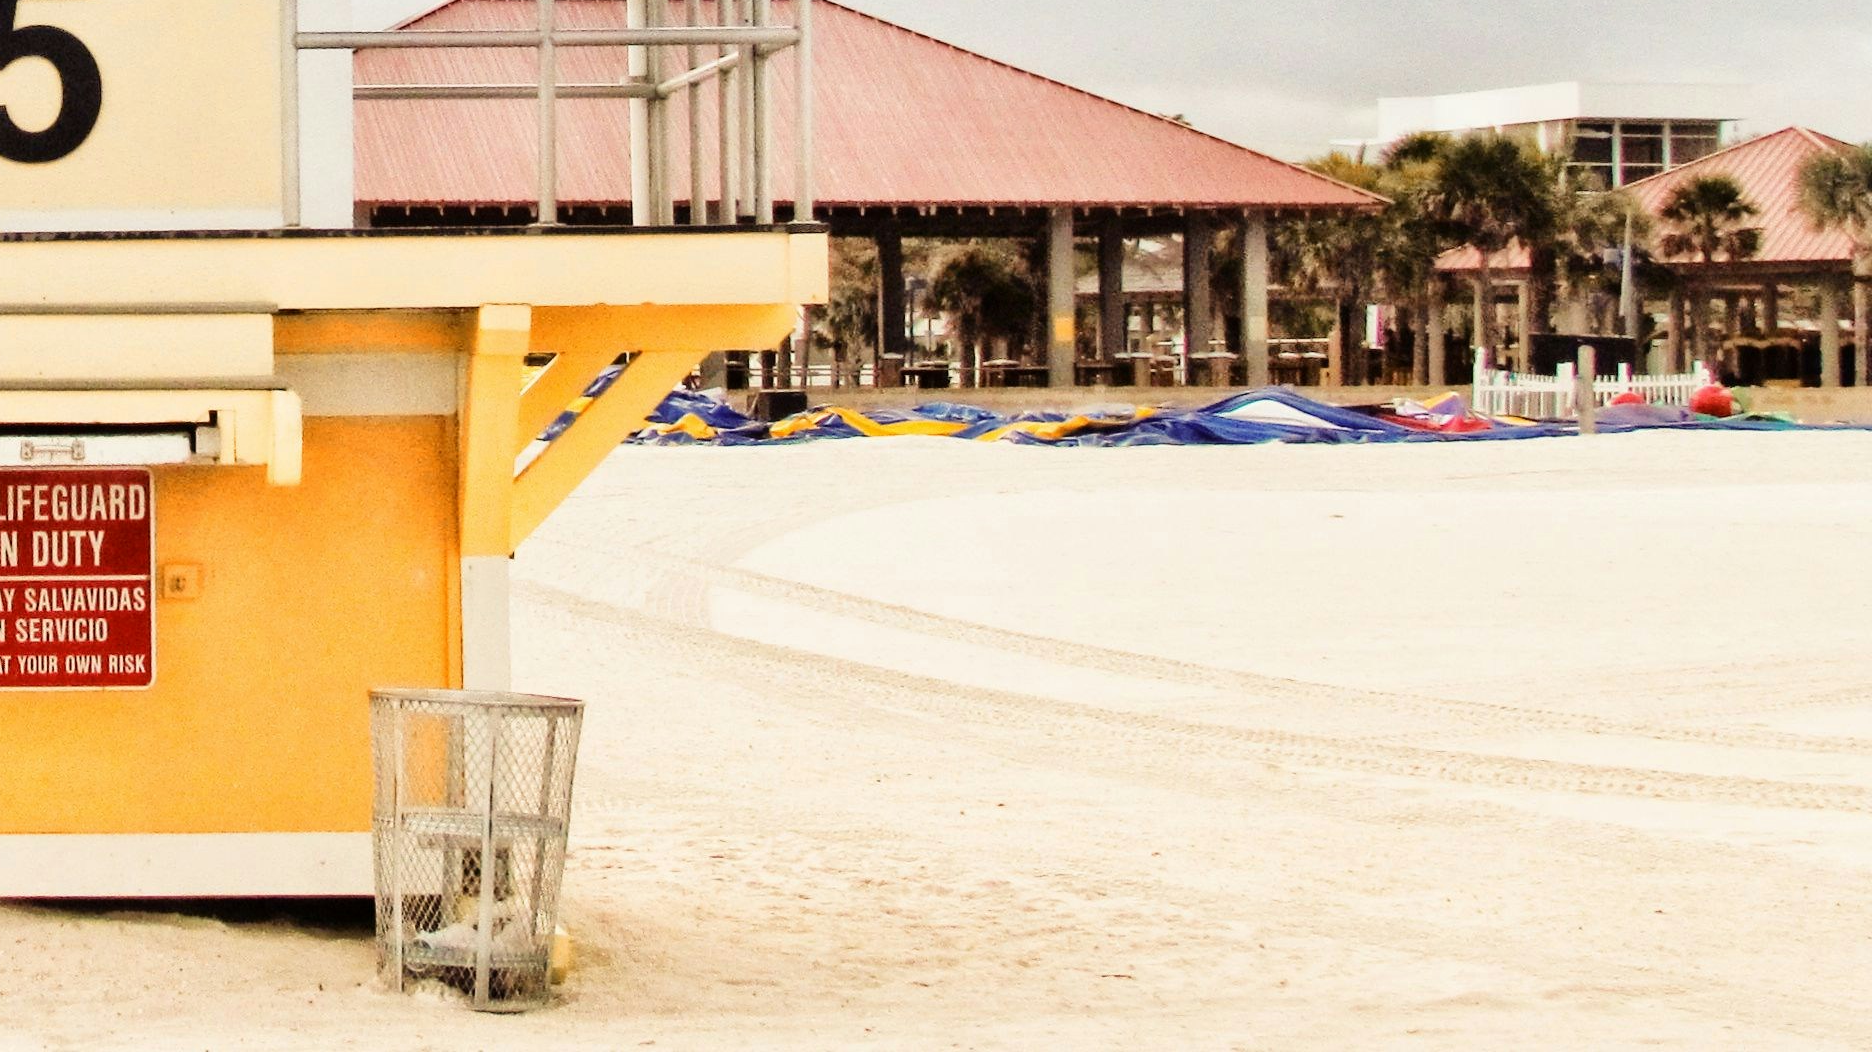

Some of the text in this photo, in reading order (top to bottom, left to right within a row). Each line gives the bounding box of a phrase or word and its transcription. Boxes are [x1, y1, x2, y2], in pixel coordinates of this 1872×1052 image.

[33, 531, 105, 567] DUTY
[24, 587, 145, 612] SALVAVIDAS
[16, 618, 108, 642] SERVICIO
[18, 656, 58, 674] YOUR
[65, 655, 101, 674] OWN
[109, 655, 146, 674] RISK
